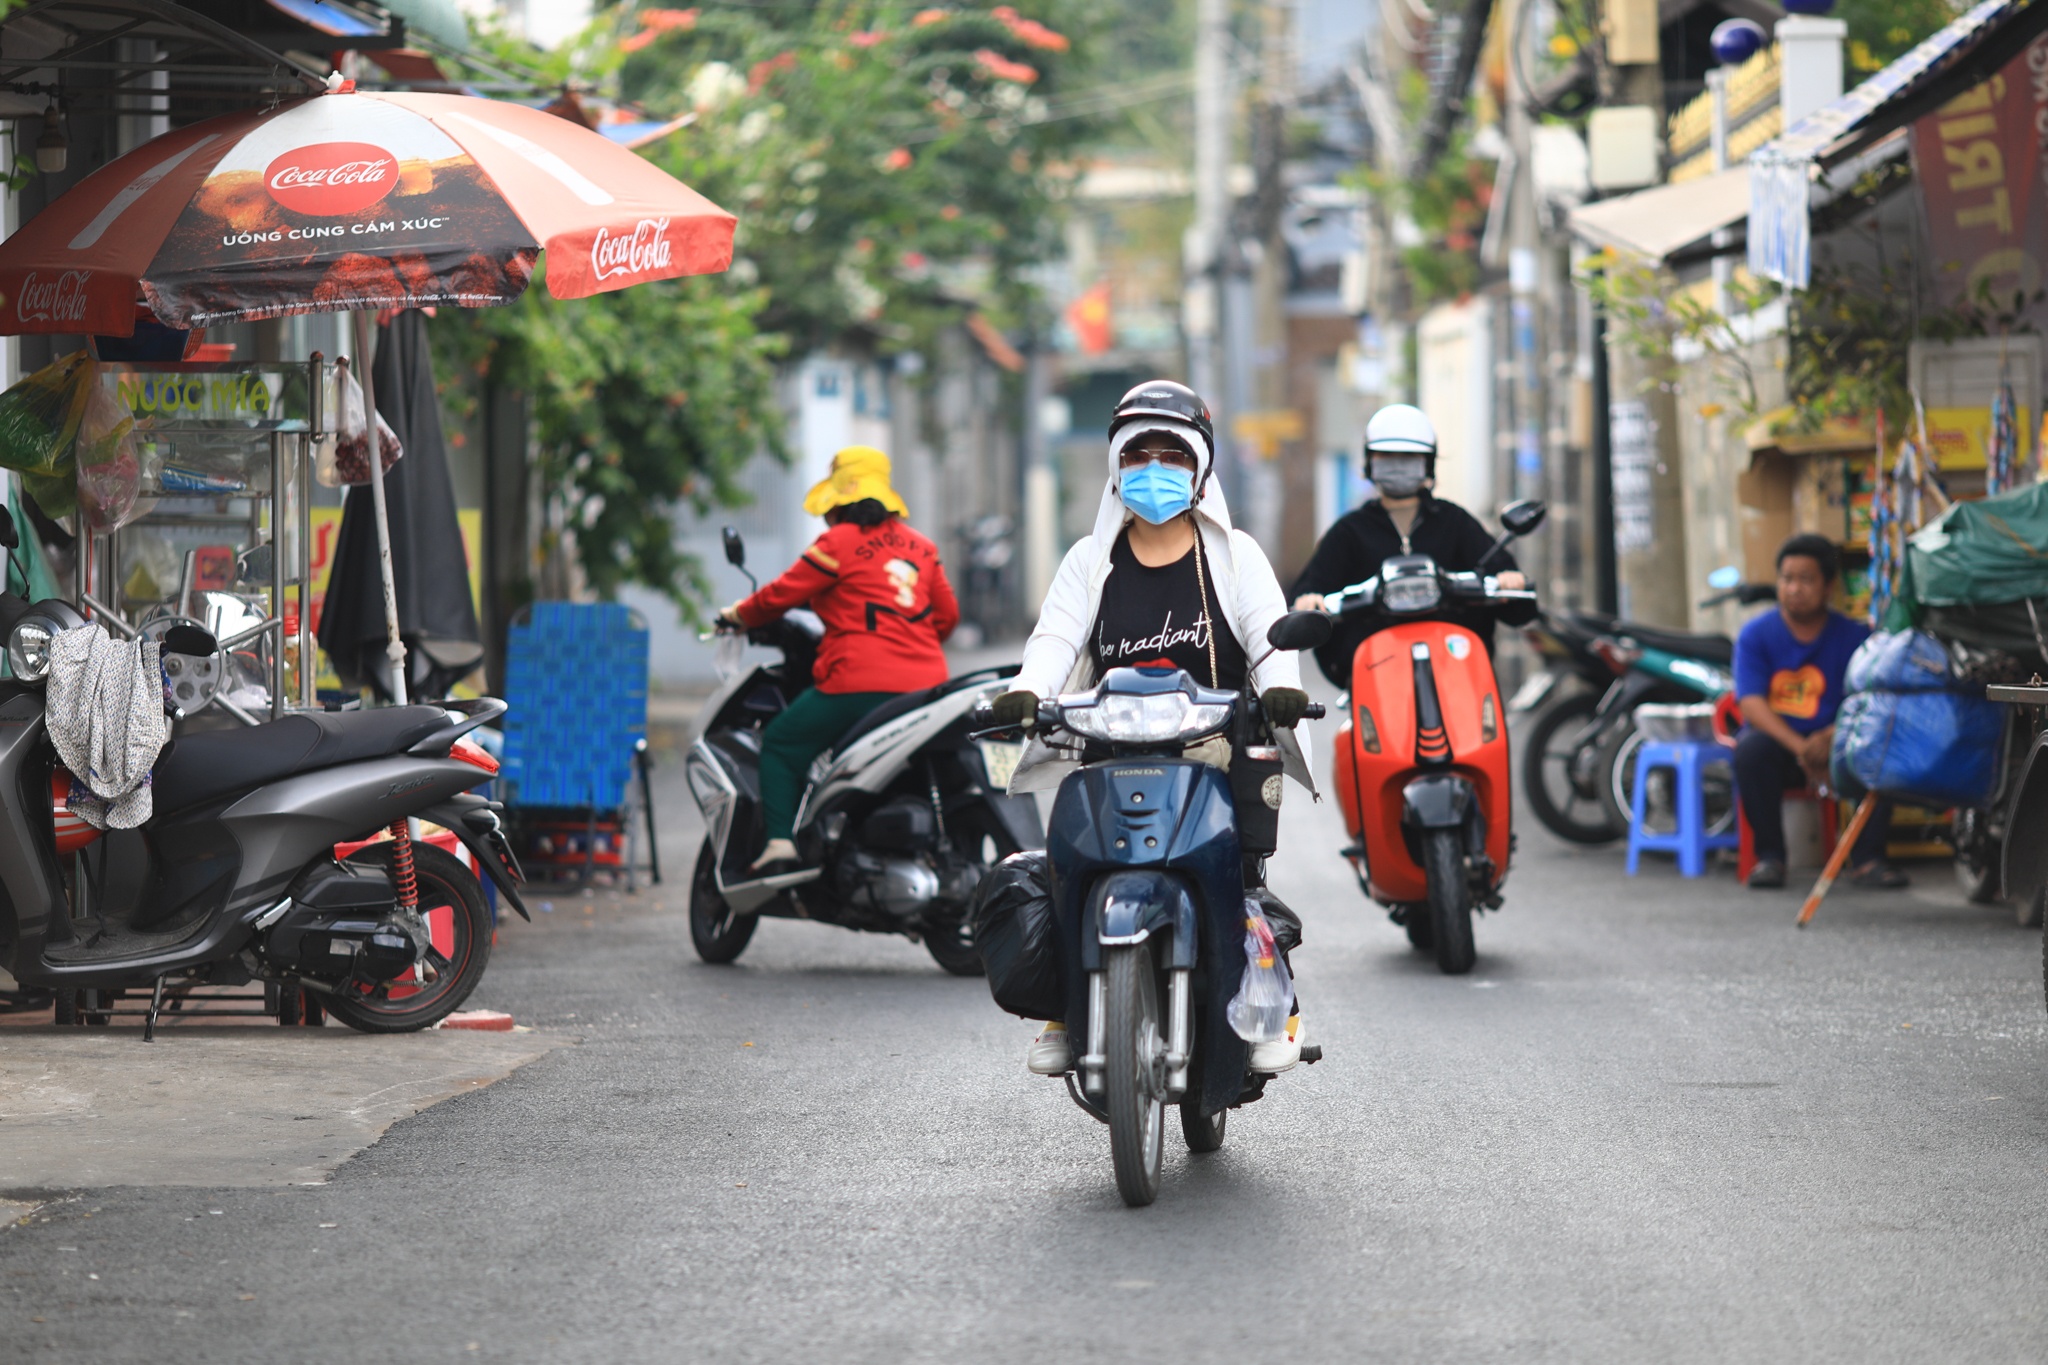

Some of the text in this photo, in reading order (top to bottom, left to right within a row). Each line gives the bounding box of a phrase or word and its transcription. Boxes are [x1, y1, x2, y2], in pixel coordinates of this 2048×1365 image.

[270, 159, 392, 189] Coca-Cola
[223, 230, 282, 246] UỐNG
[288, 225, 345, 240] CÙNG
[591, 217, 672, 281] Coca-Cola
[17, 270, 93, 323] Coca-Cola
[117, 373, 270, 412] NƯỚC MÍA
[1119, 610, 1213, 658] radiant
[1113, 768, 1163, 777] HONDA
